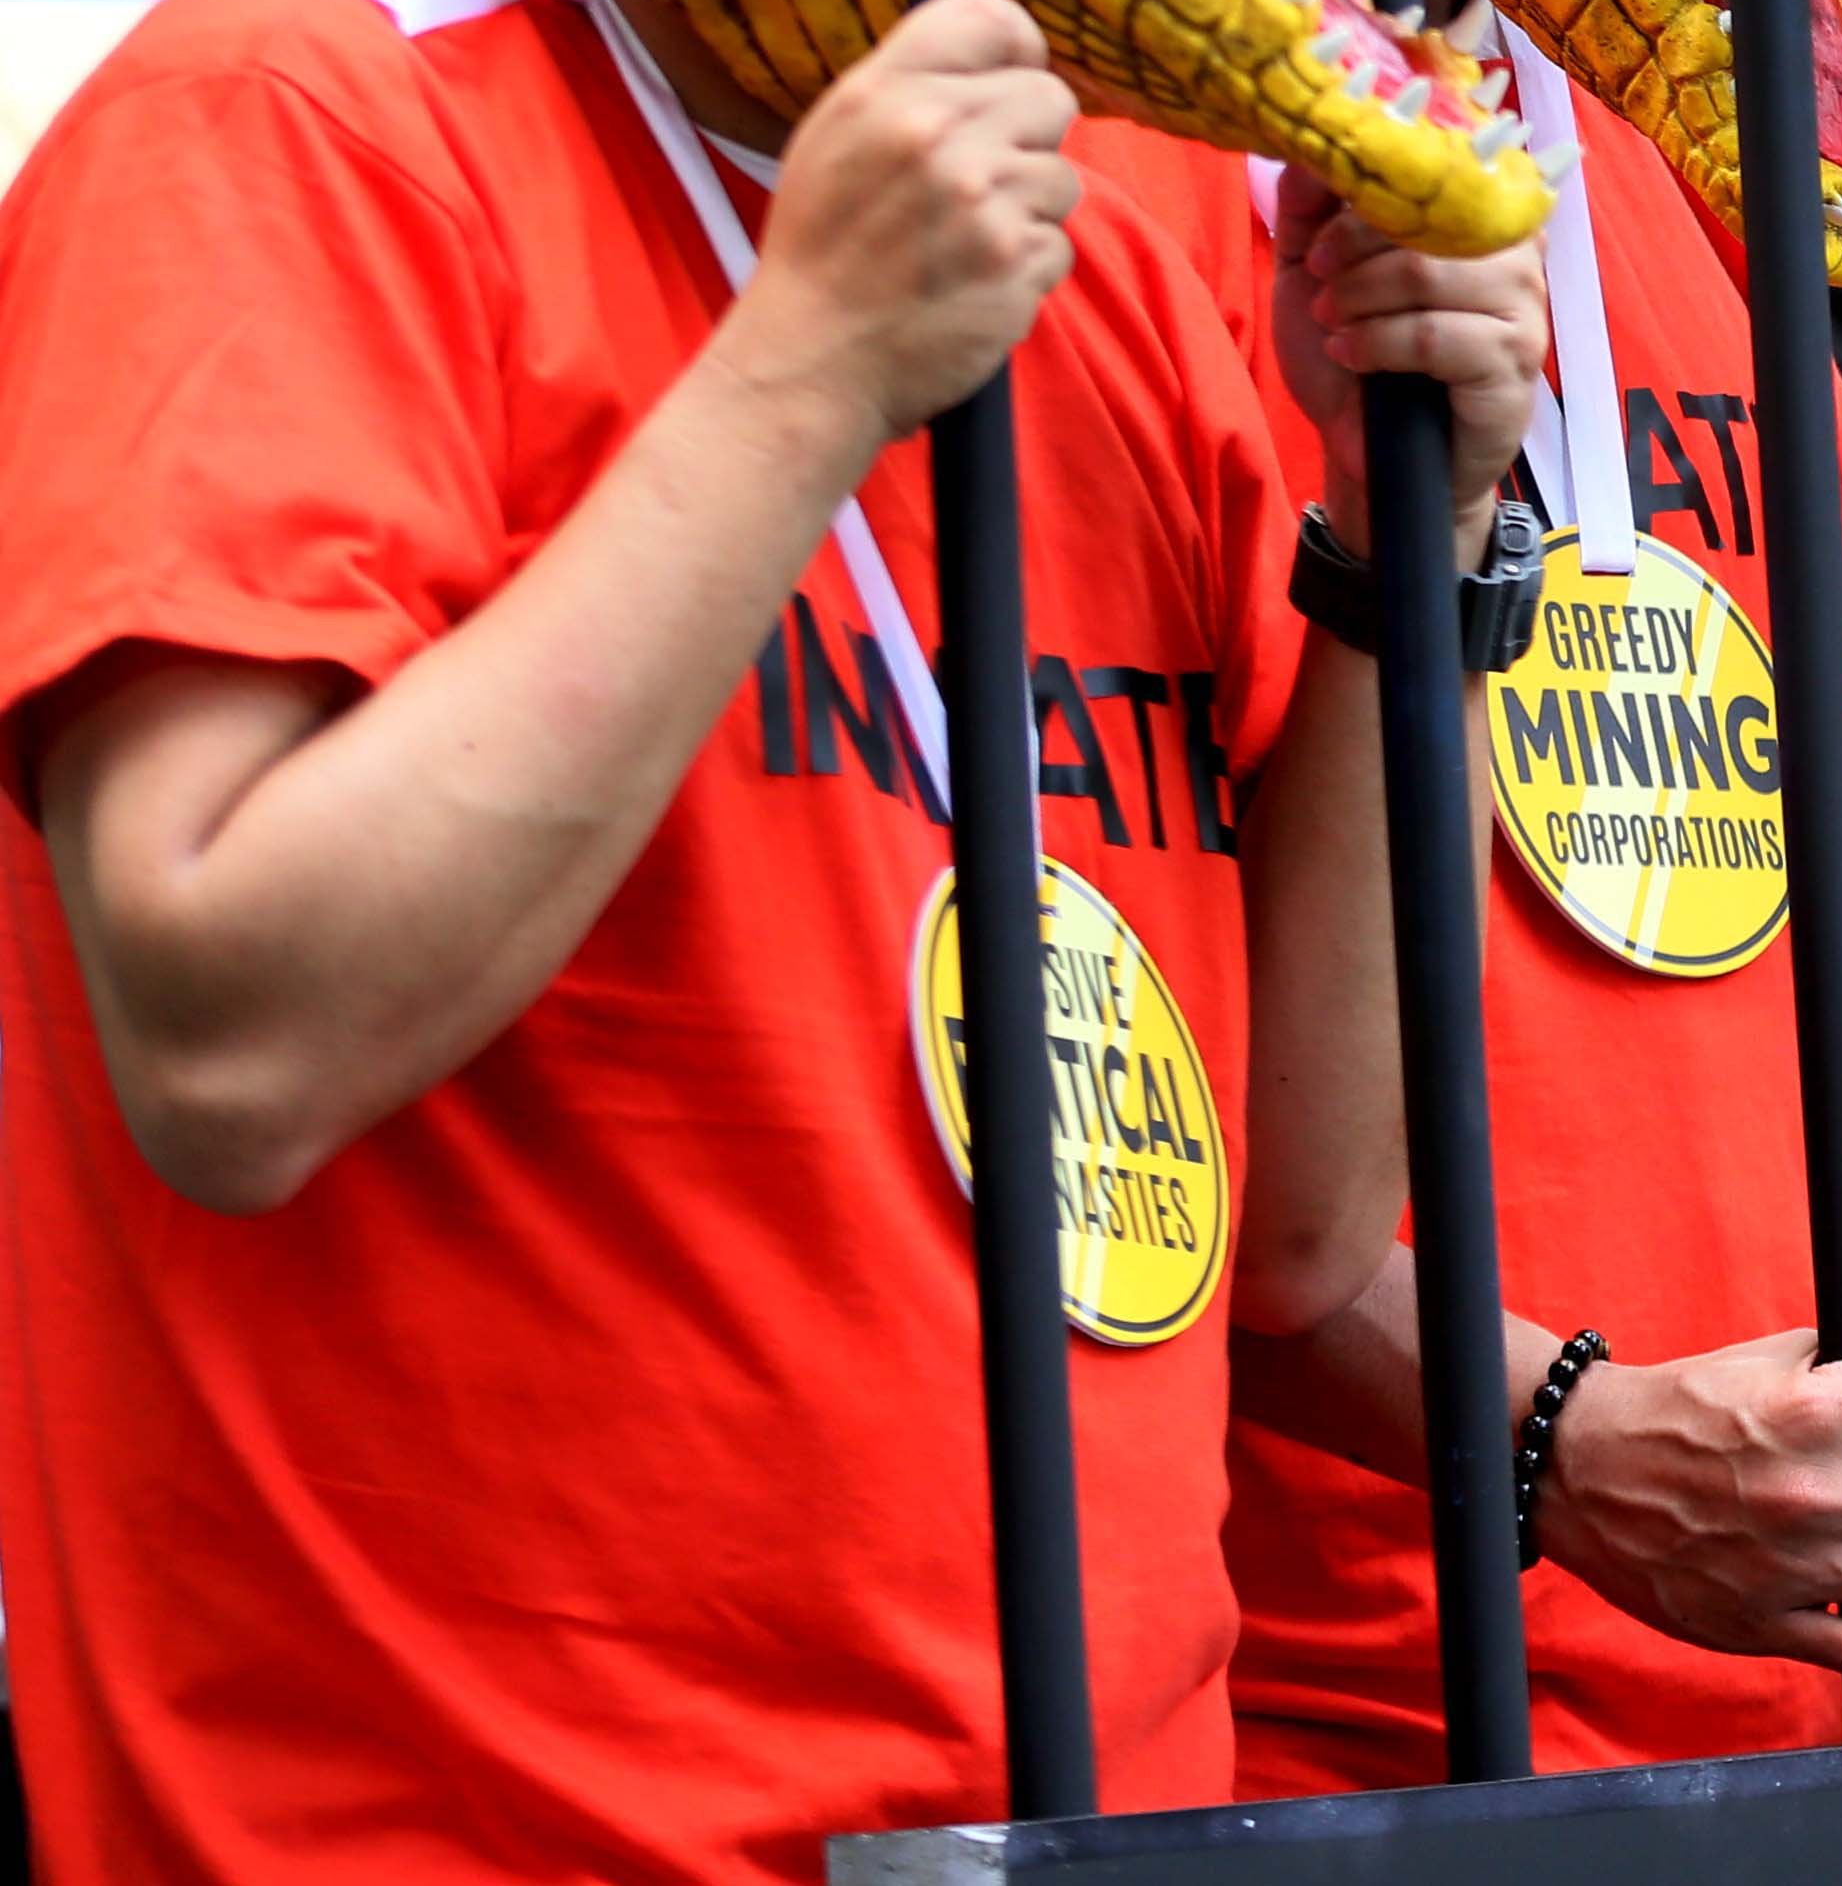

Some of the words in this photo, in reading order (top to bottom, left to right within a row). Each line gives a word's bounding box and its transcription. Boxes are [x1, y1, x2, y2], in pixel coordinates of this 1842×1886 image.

[1544, 600, 1699, 676] GREEDY
[755, 591, 1237, 857] INATE
[1499, 686, 1782, 795] MINING
[1546, 810, 1785, 872] CORPORATIONS
[1042, 942, 1131, 1030] SIVE
[1053, 1154, 1197, 1253] NASTIES
